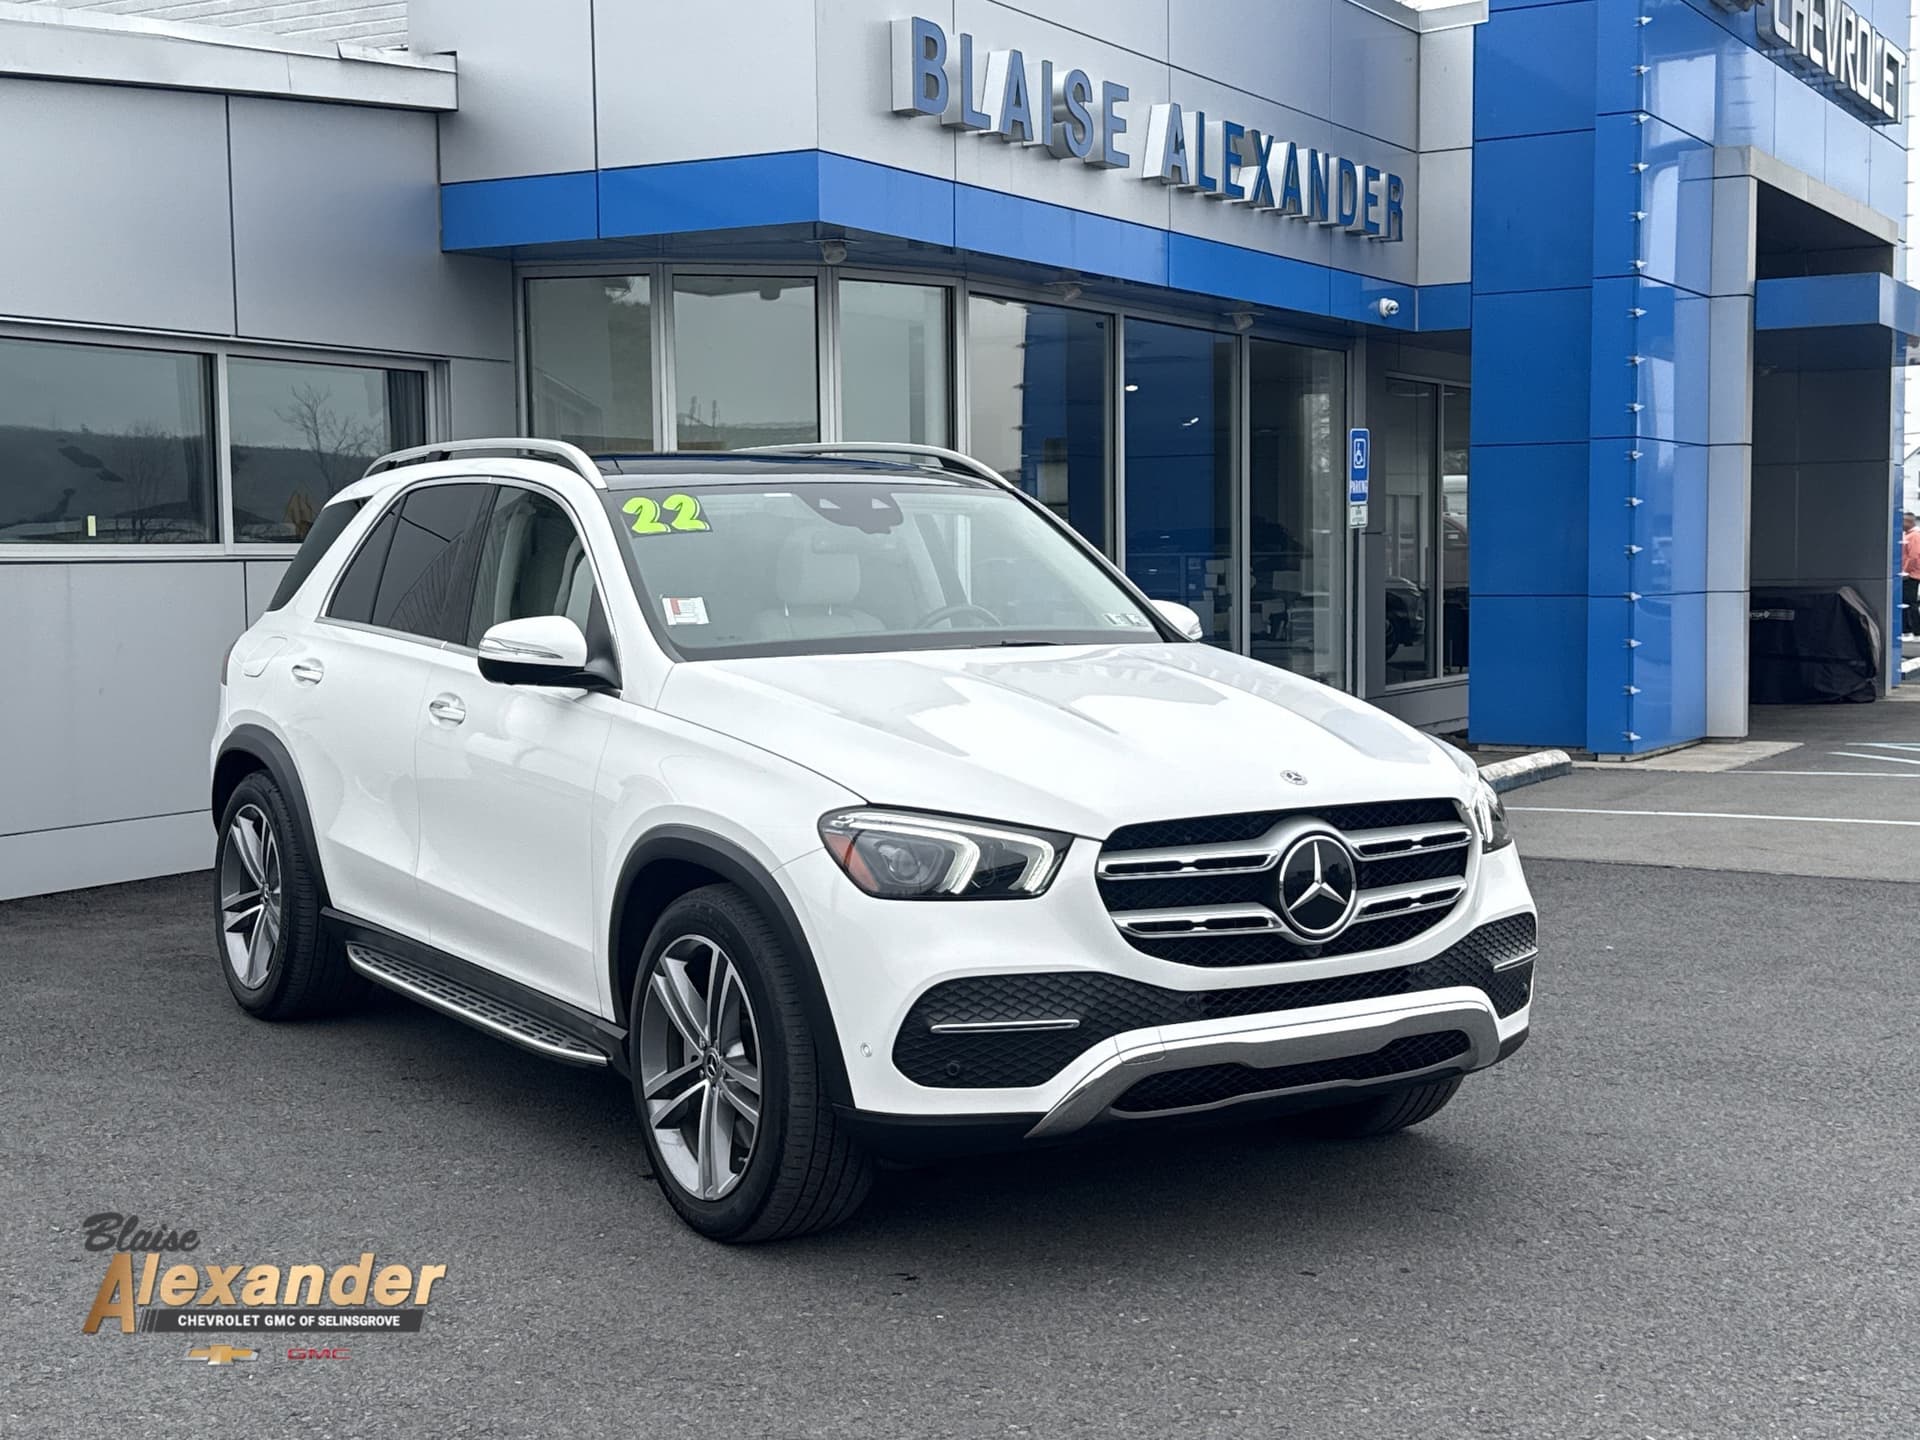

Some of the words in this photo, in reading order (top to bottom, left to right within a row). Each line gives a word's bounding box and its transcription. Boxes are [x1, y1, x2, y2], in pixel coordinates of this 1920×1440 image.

[905, 15, 1131, 168] BLAISE
[1160, 102, 1405, 242] ALEXANDER
[622, 493, 711, 534] 22
